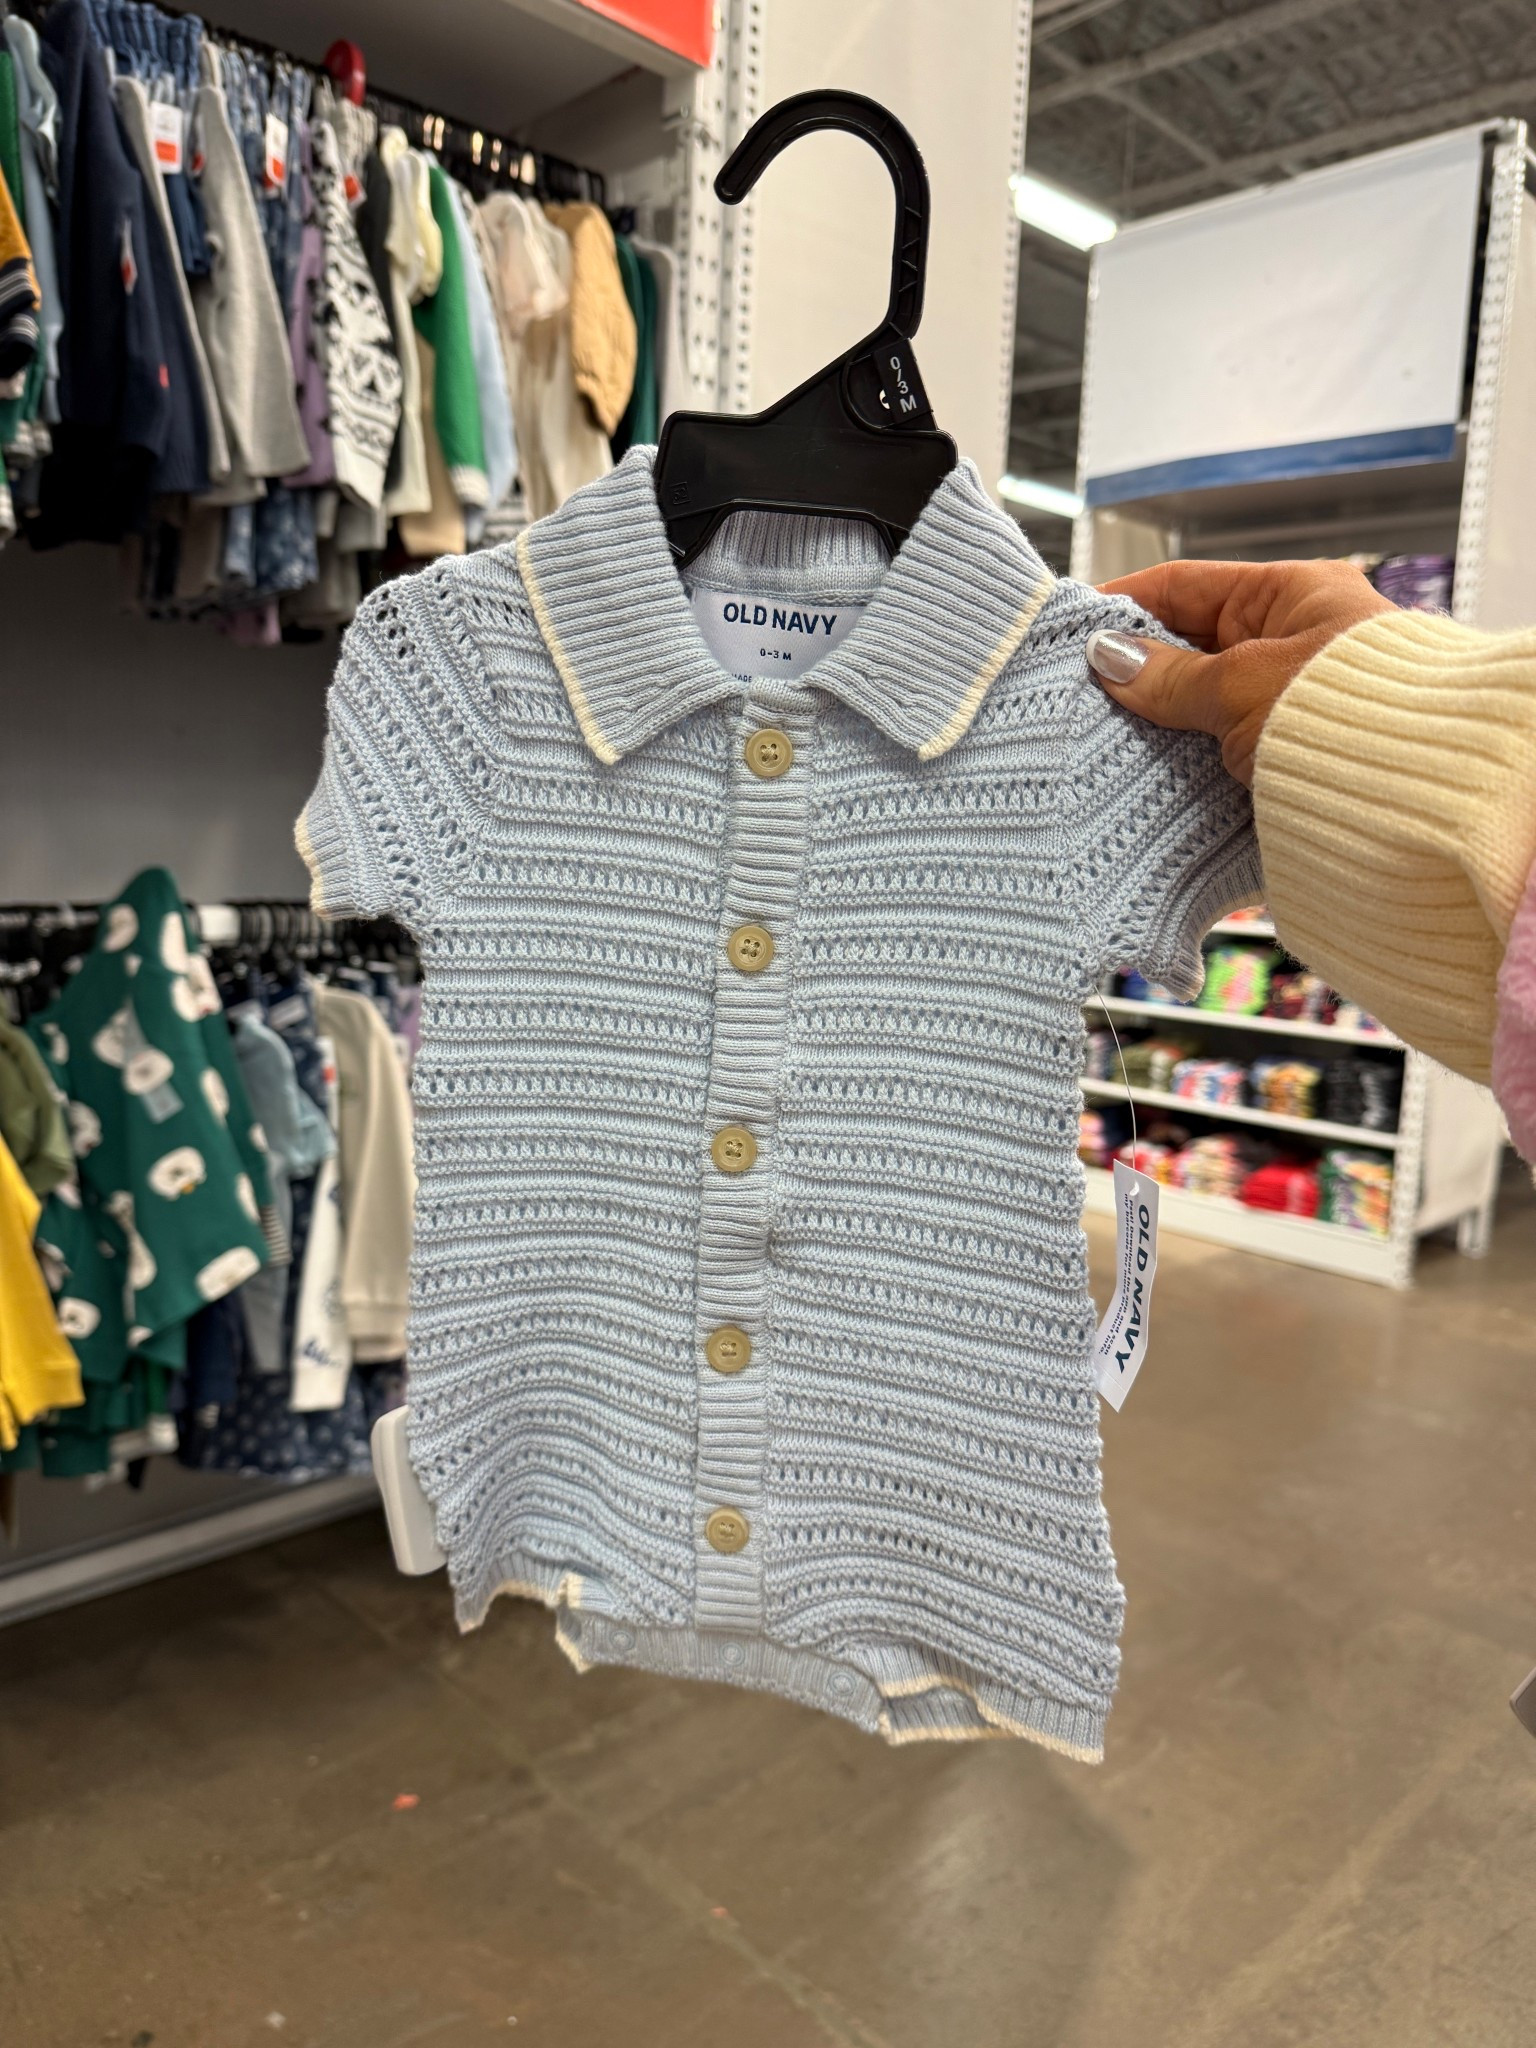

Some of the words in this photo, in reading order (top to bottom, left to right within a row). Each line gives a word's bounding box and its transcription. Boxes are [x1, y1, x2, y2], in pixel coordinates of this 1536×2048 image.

[723, 602, 767, 626] OLD
[772, 608, 837, 635] NAVY
[759, 648, 780, 659] 0-3
[782, 652, 792, 661] M
[1137, 1204, 1150, 1271] OLD
[1110, 1296, 1125, 1333] product
[1115, 1315, 1124, 1333] and
[1115, 1277, 1143, 1373] NAVY
